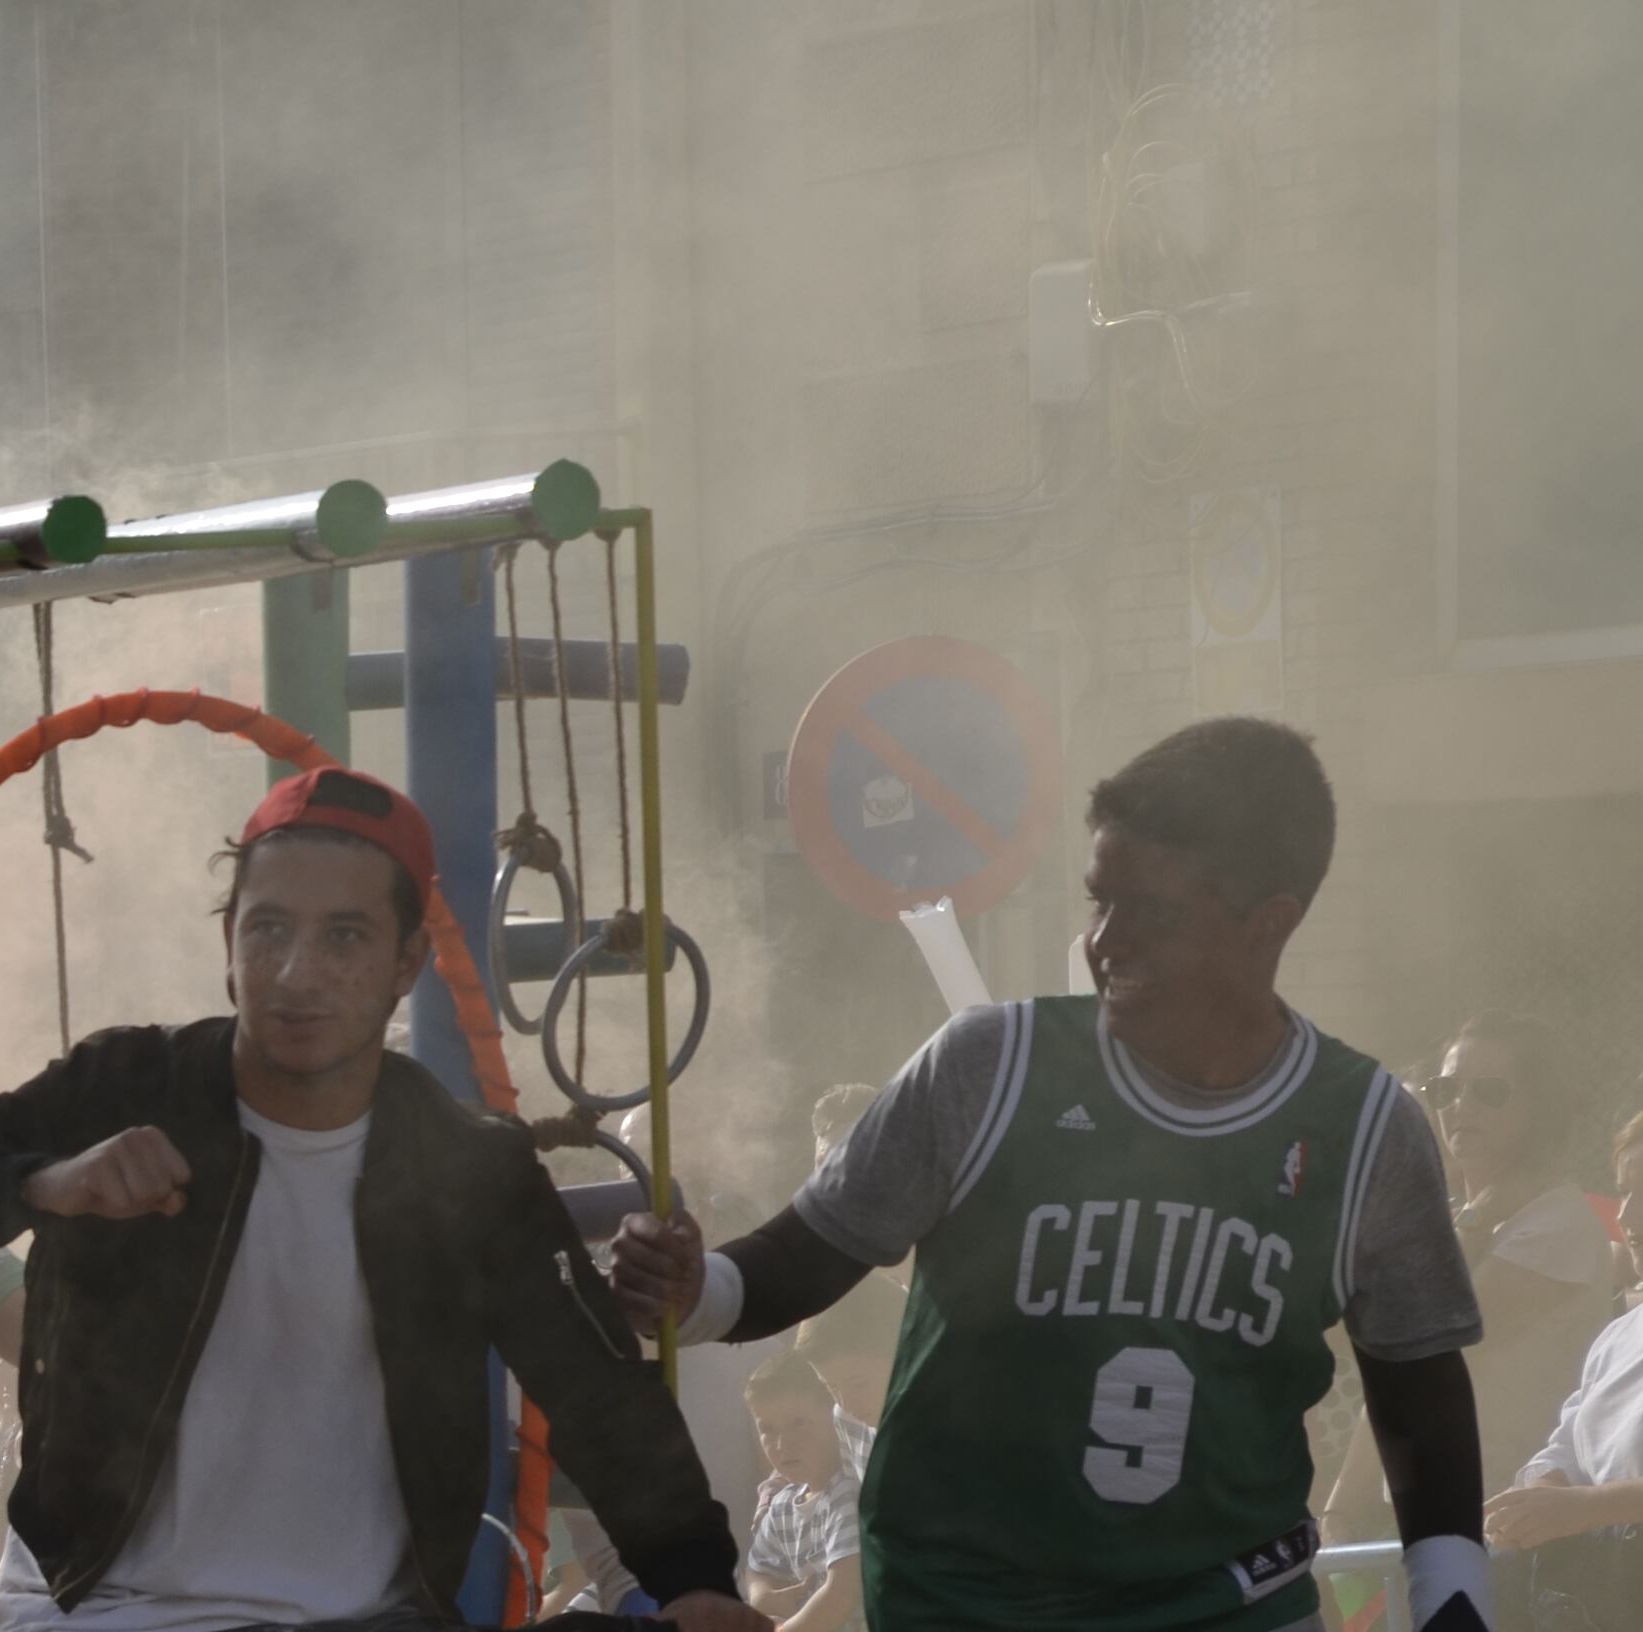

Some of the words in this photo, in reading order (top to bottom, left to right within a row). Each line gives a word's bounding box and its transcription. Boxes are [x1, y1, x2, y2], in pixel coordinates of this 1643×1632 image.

[1056, 1118, 1096, 1131] adidas
[1015, 1197, 1294, 1347] CELTICS
[1082, 1345, 1196, 1505] 9
